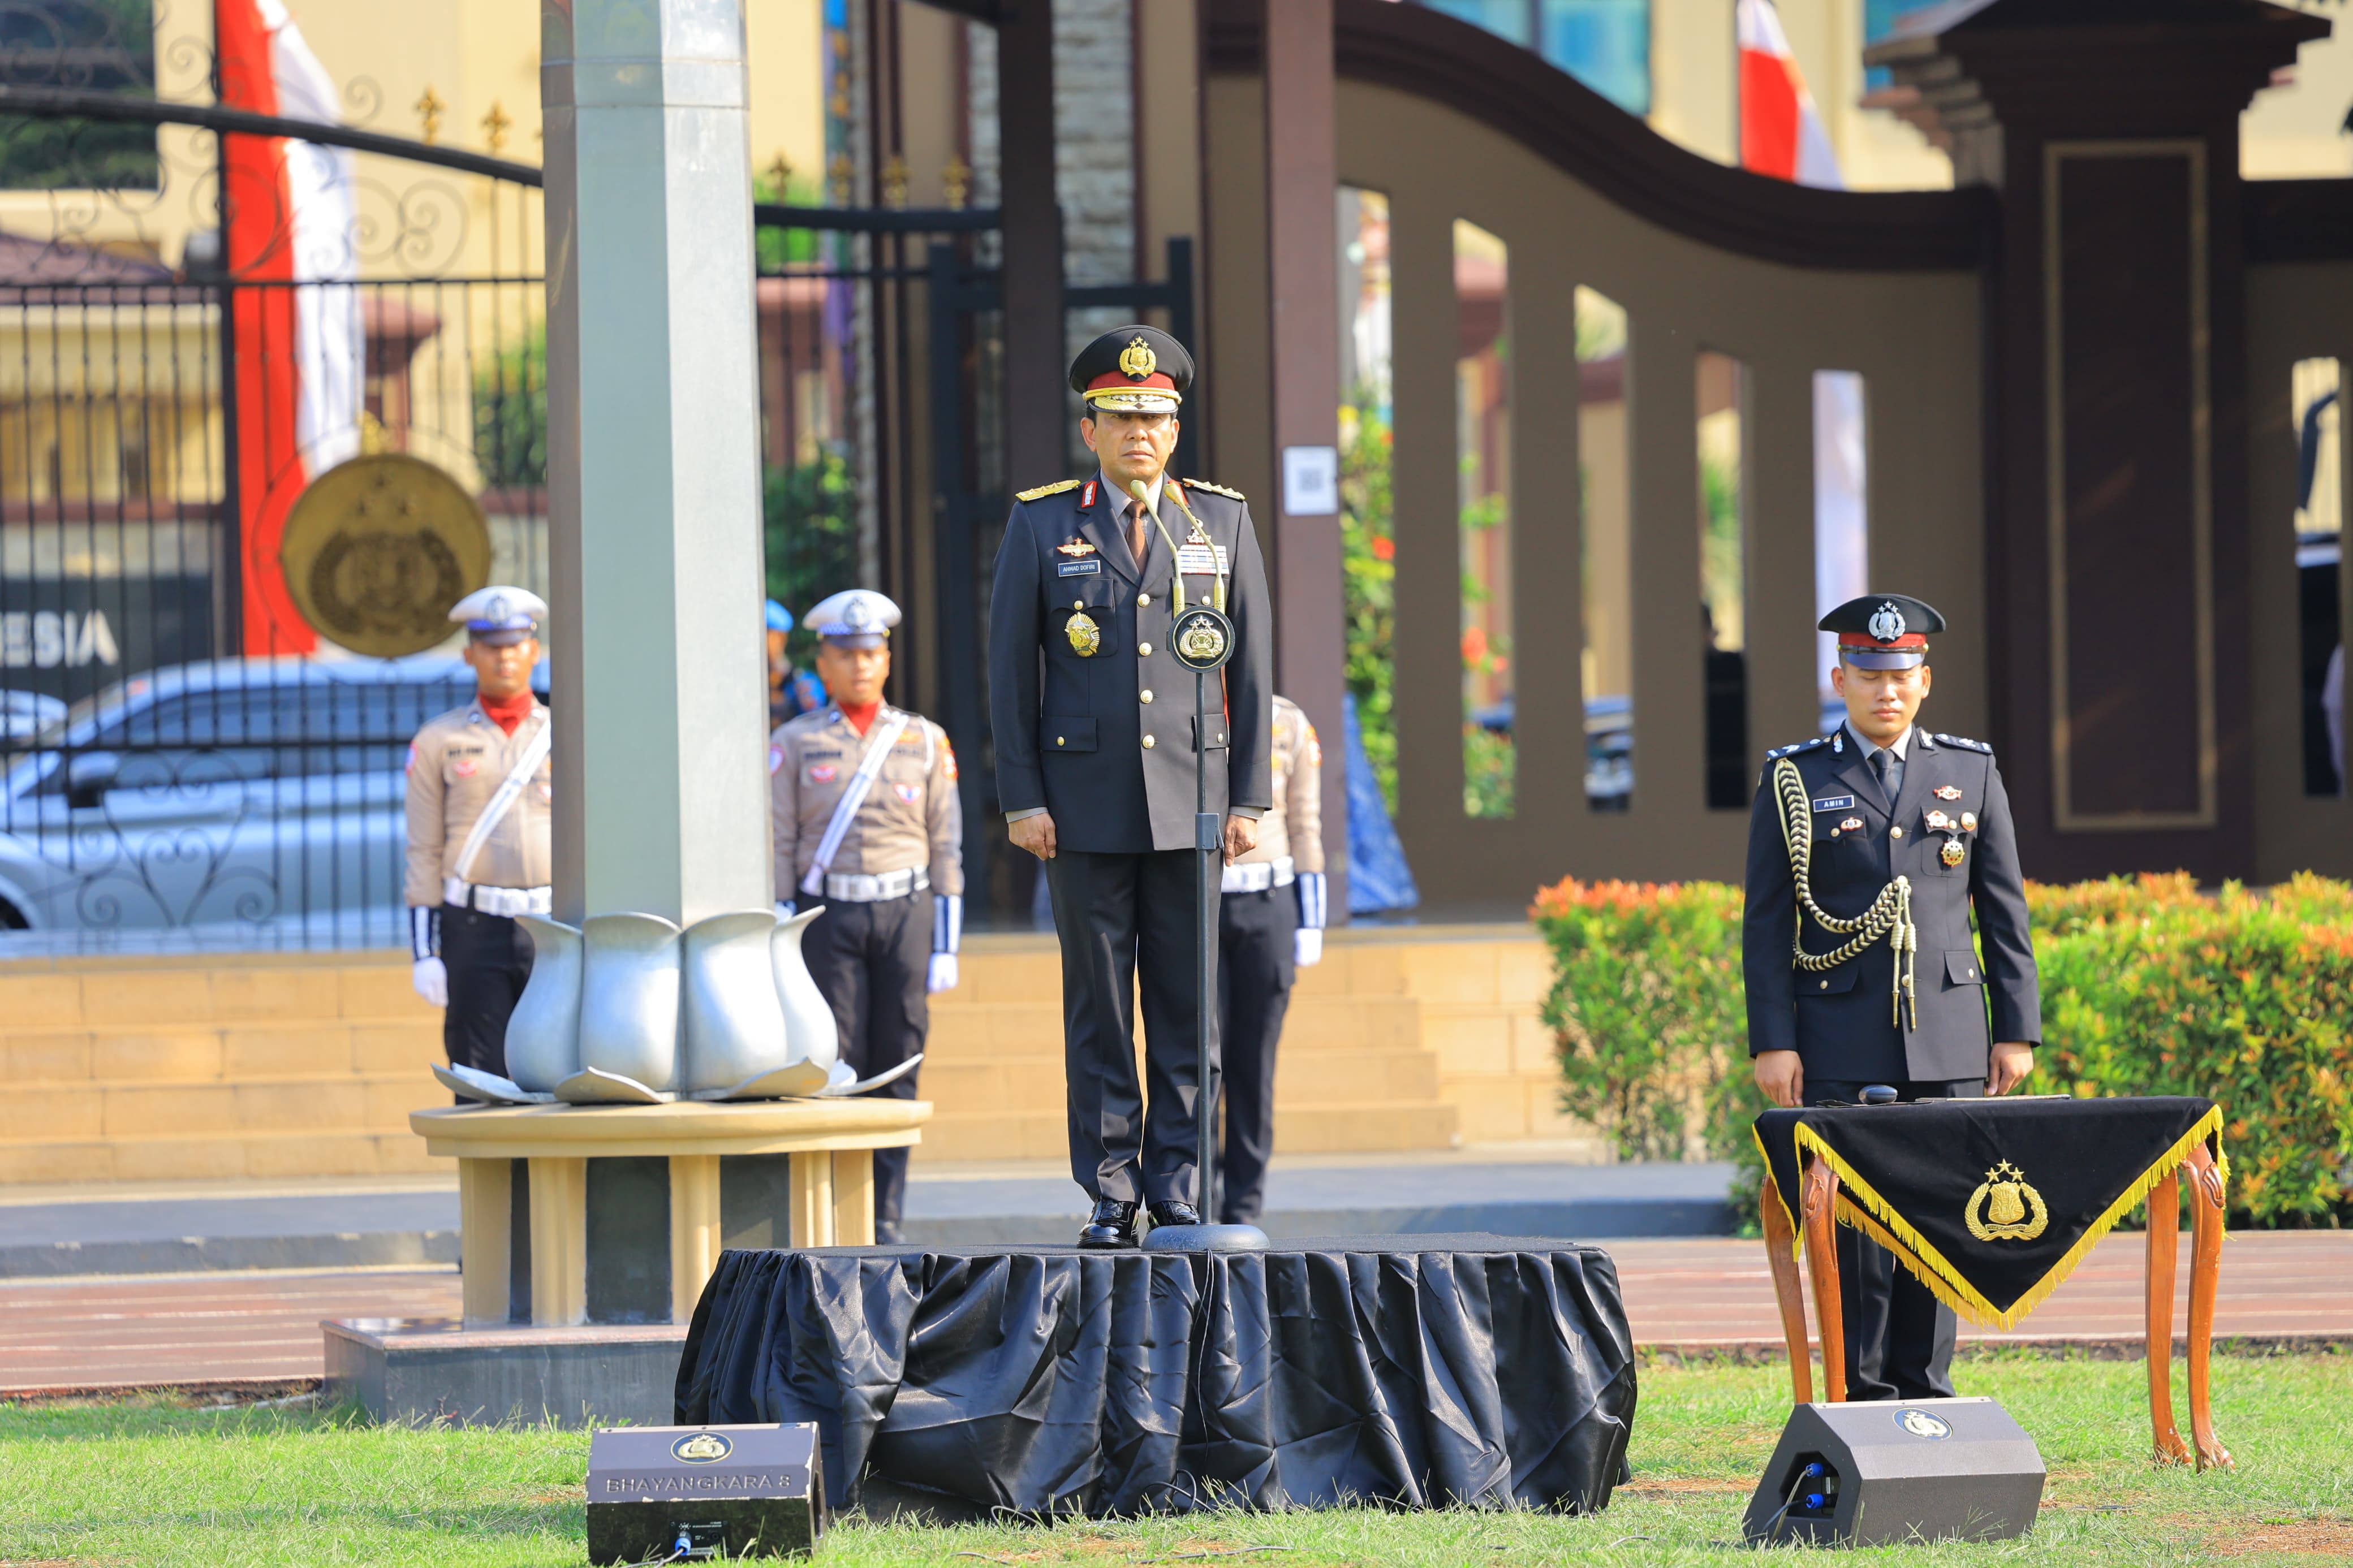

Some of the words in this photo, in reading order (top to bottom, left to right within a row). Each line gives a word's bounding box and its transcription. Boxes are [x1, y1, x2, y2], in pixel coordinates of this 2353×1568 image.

[0, 609, 119, 668] ESIA
[1824, 799, 1844, 808] AMIN
[606, 1475, 773, 1492] BHAYANGKARA
[779, 1475, 791, 1488] 8
